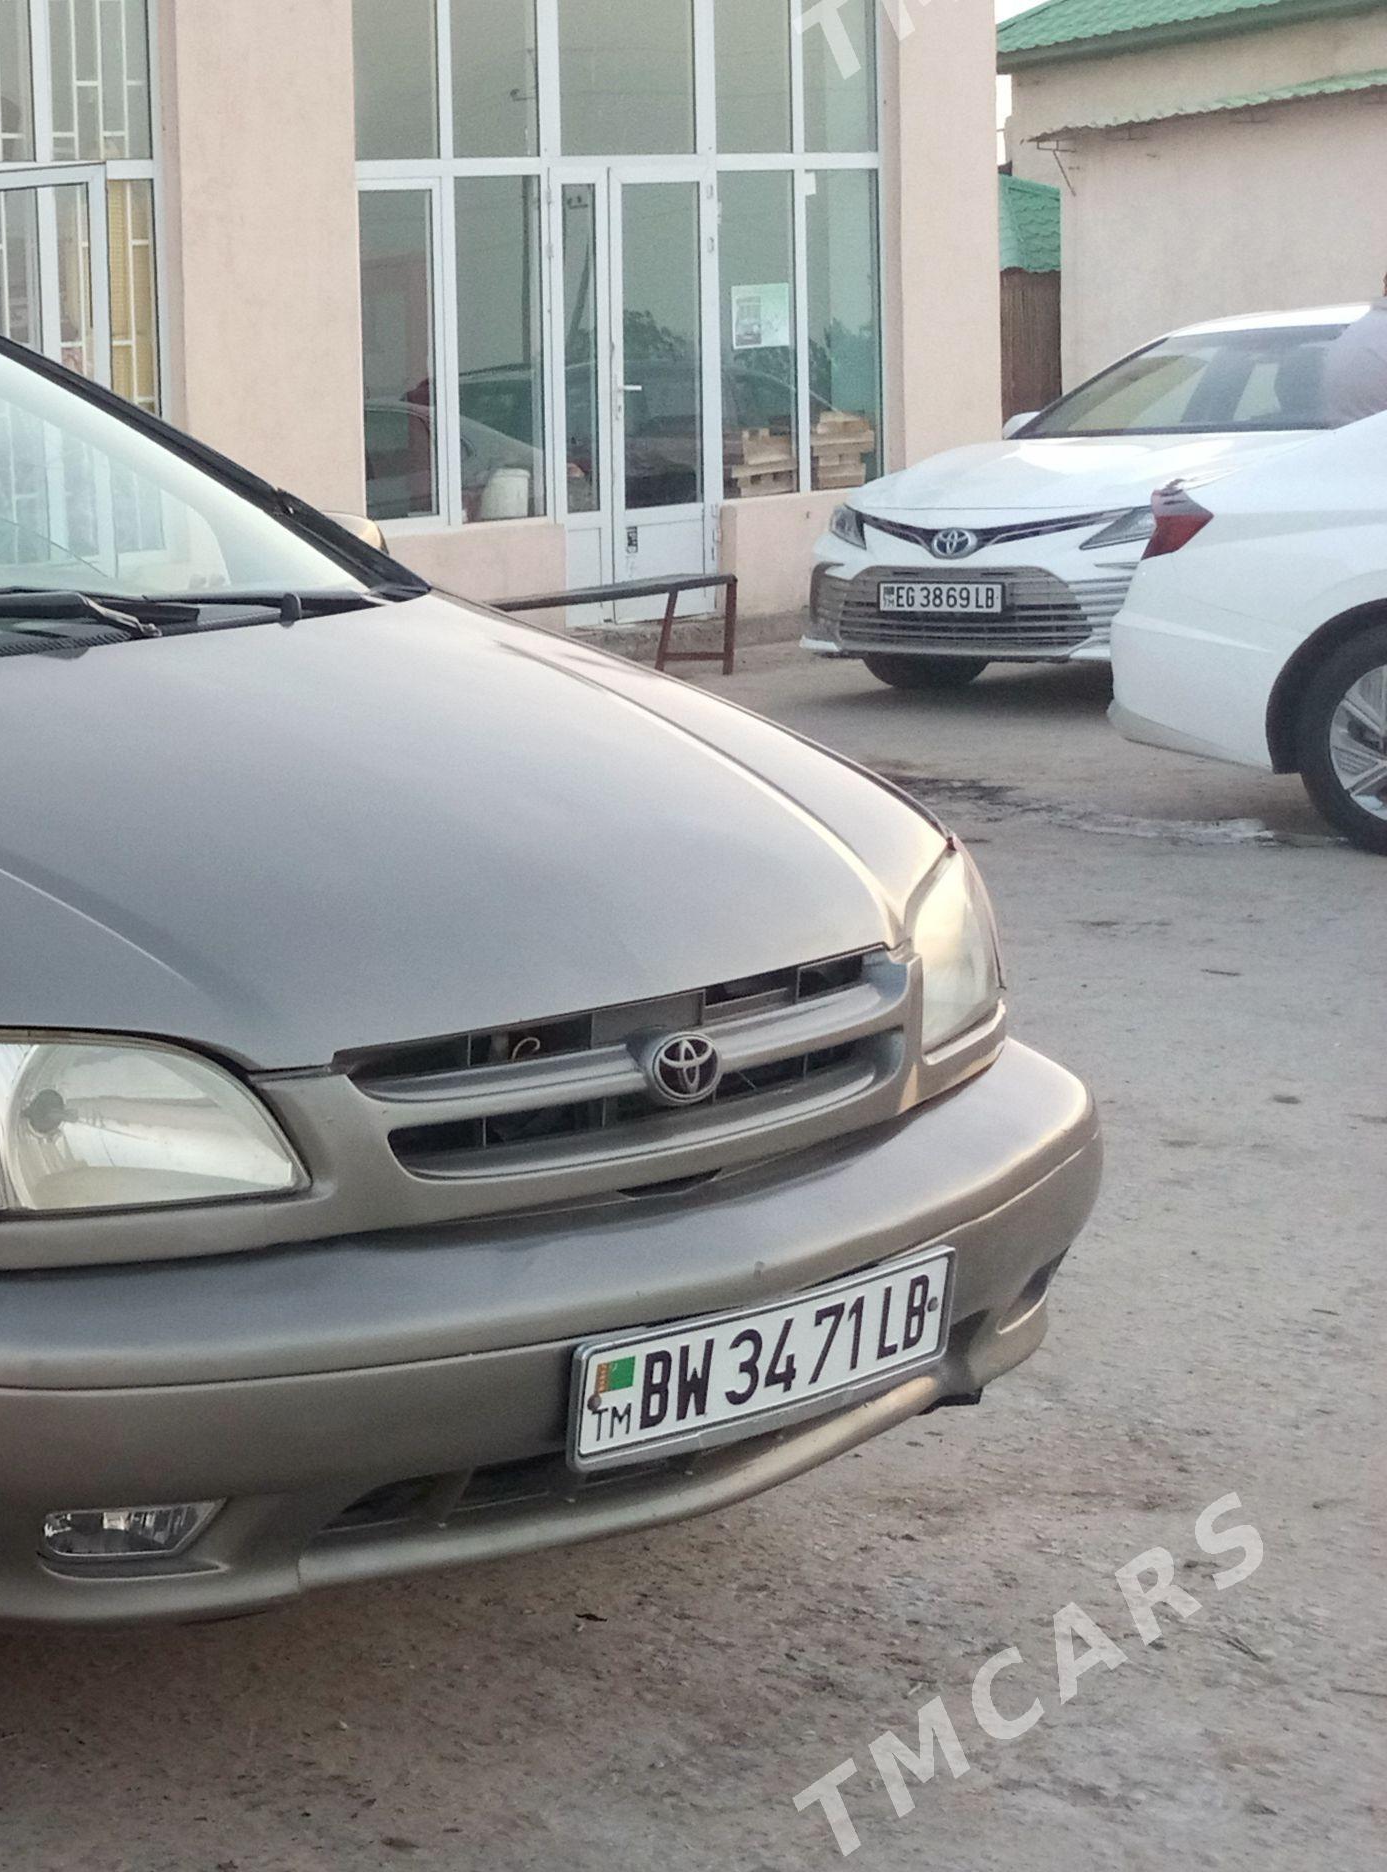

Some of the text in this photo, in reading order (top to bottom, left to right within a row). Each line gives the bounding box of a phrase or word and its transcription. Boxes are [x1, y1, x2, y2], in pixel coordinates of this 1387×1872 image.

[896, 586, 915, 608] EG
[975, 587, 994, 608] LB
[639, 1338, 715, 1431] BW
[876, 1273, 929, 1361] LB
[591, 1402, 632, 1442] TM
